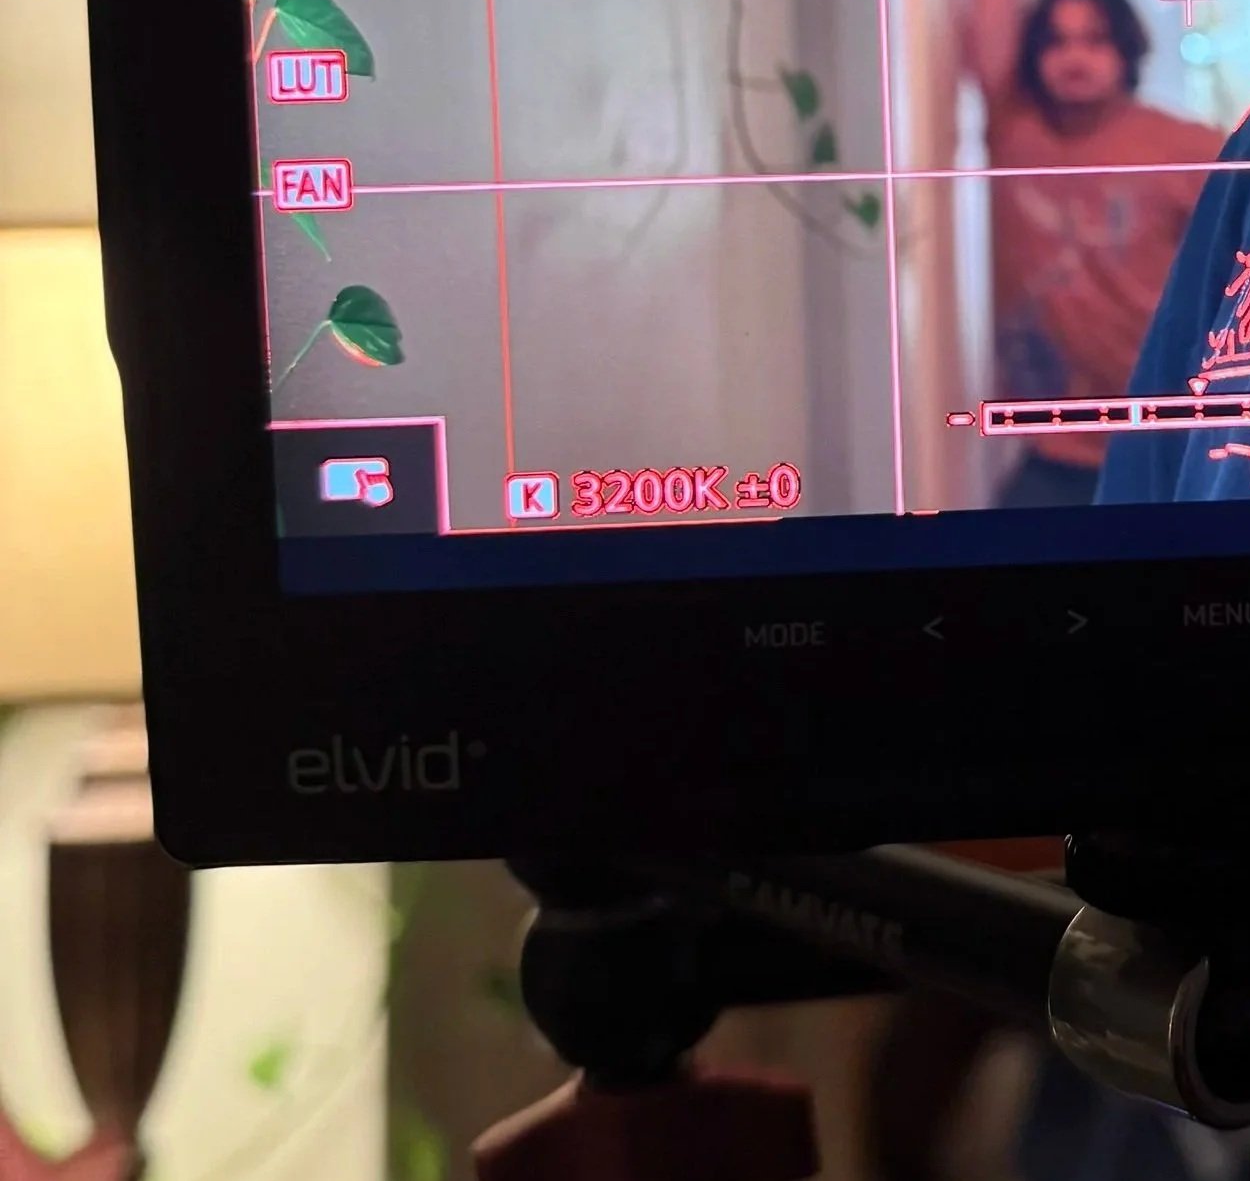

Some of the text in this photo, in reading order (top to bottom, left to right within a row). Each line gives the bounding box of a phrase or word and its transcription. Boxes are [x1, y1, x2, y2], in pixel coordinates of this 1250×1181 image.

[276, 58, 340, 96] LUT
[281, 168, 344, 203] FAN
[570, 464, 731, 517] 3200K
[743, 621, 827, 649] MODE
[287, 728, 462, 795] elvid
